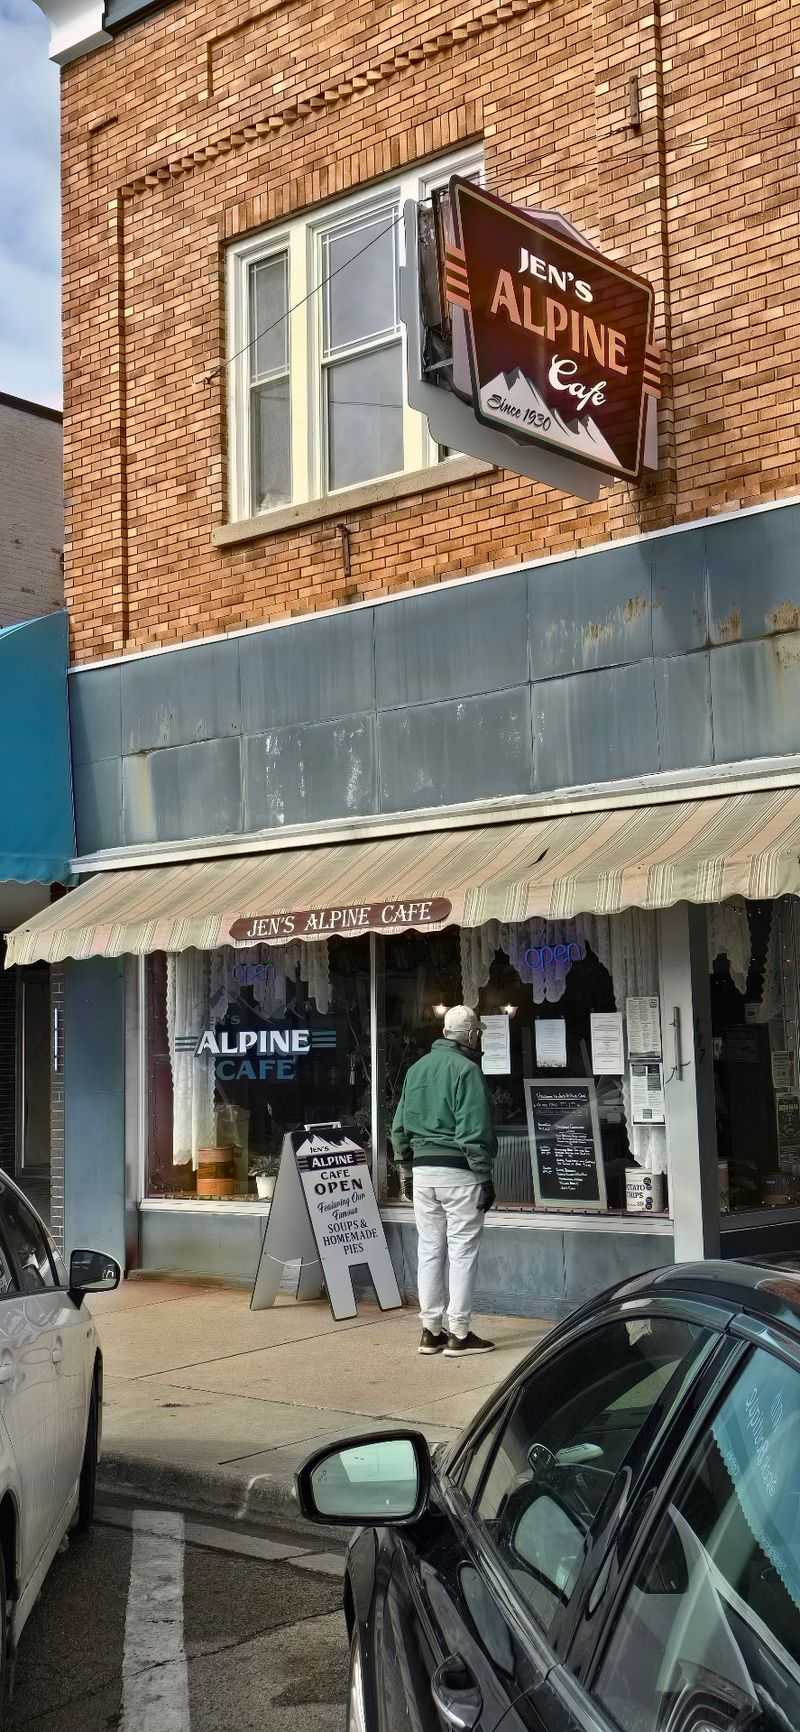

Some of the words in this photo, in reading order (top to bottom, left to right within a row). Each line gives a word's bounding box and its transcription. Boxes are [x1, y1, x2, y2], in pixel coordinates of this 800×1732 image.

[518, 248, 594, 303] JEN'S
[490, 268, 628, 375] ALPINE
[548, 354, 607, 411] Cafe
[486, 393, 522, 419] Since
[523, 408, 552, 432] 1930
[247, 916, 296, 937] JEN'S
[304, 907, 371, 931] ALPINE
[381, 902, 433, 925] CAFE
[524, 943, 583, 972] open
[195, 1029, 312, 1057] ALPINE
[215, 1059, 296, 1081] CAFE
[310, 1146, 330, 1154] JEN'S
[311, 1154, 354, 1168] ALPINE
[320, 1169, 350, 1180] CAFE
[314, 1178, 363, 1195] OPEN
[322, 1228, 378, 1247] HOMEMADE
[327, 1220, 359, 1234] SOUPS
[360, 1219, 368, 1229] &
[343, 1243, 364, 1255] PIES
